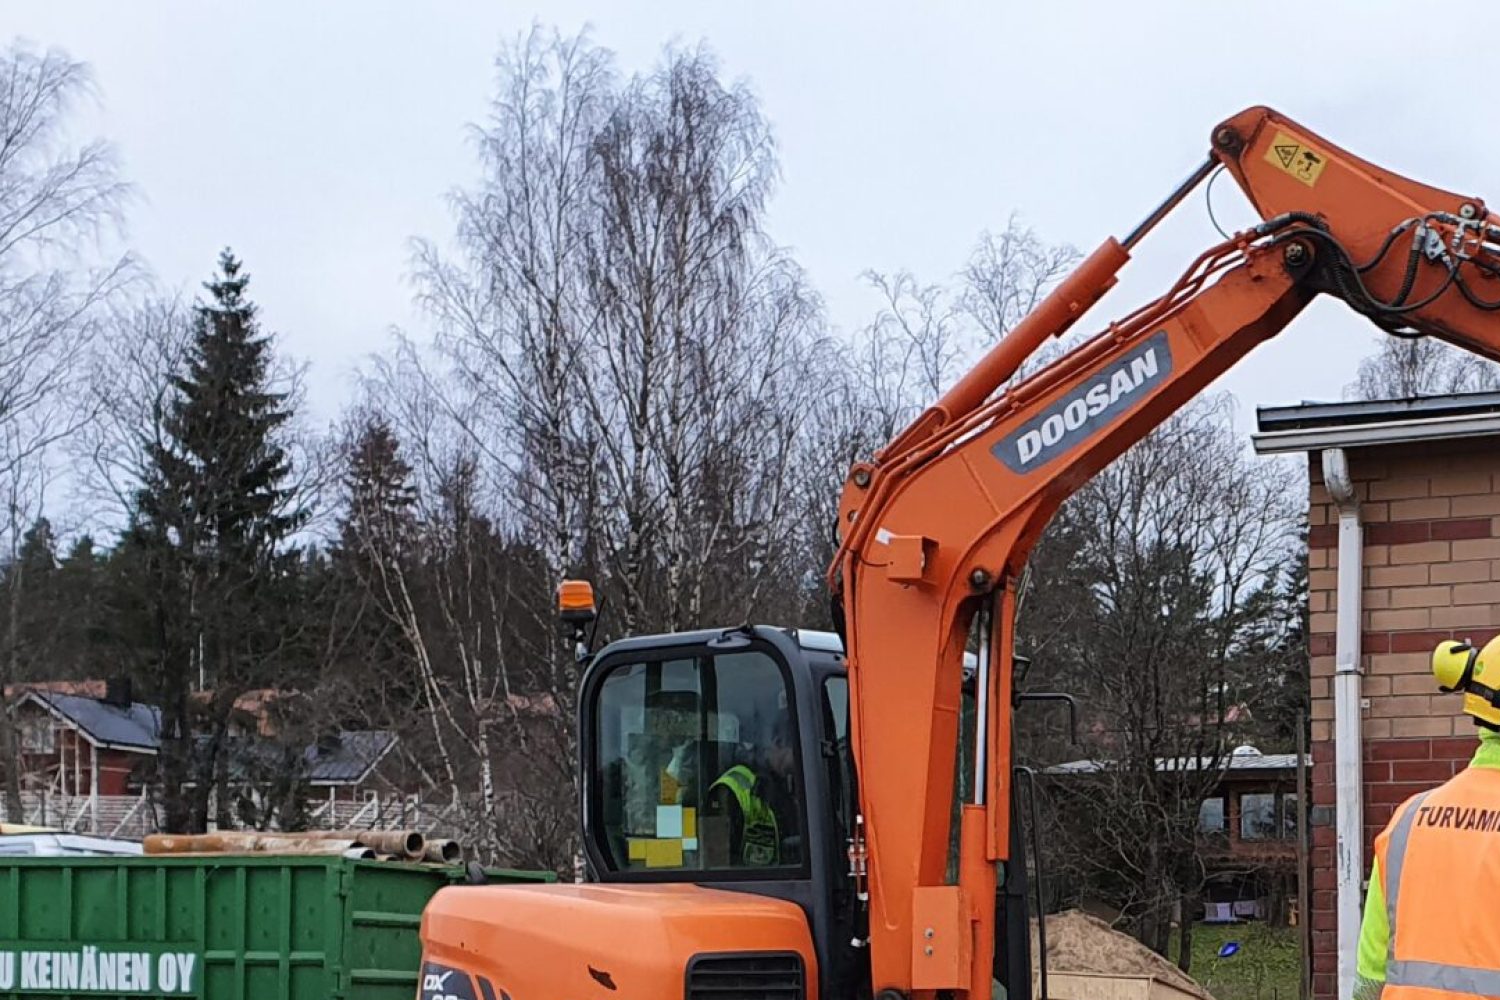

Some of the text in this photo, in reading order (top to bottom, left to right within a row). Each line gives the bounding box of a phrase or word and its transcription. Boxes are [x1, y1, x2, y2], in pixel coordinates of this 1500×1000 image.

[1017, 347, 1158, 465] DOOSAN
[21, 945, 150, 991] KEINÄNEN
[158, 953, 196, 993] OY
